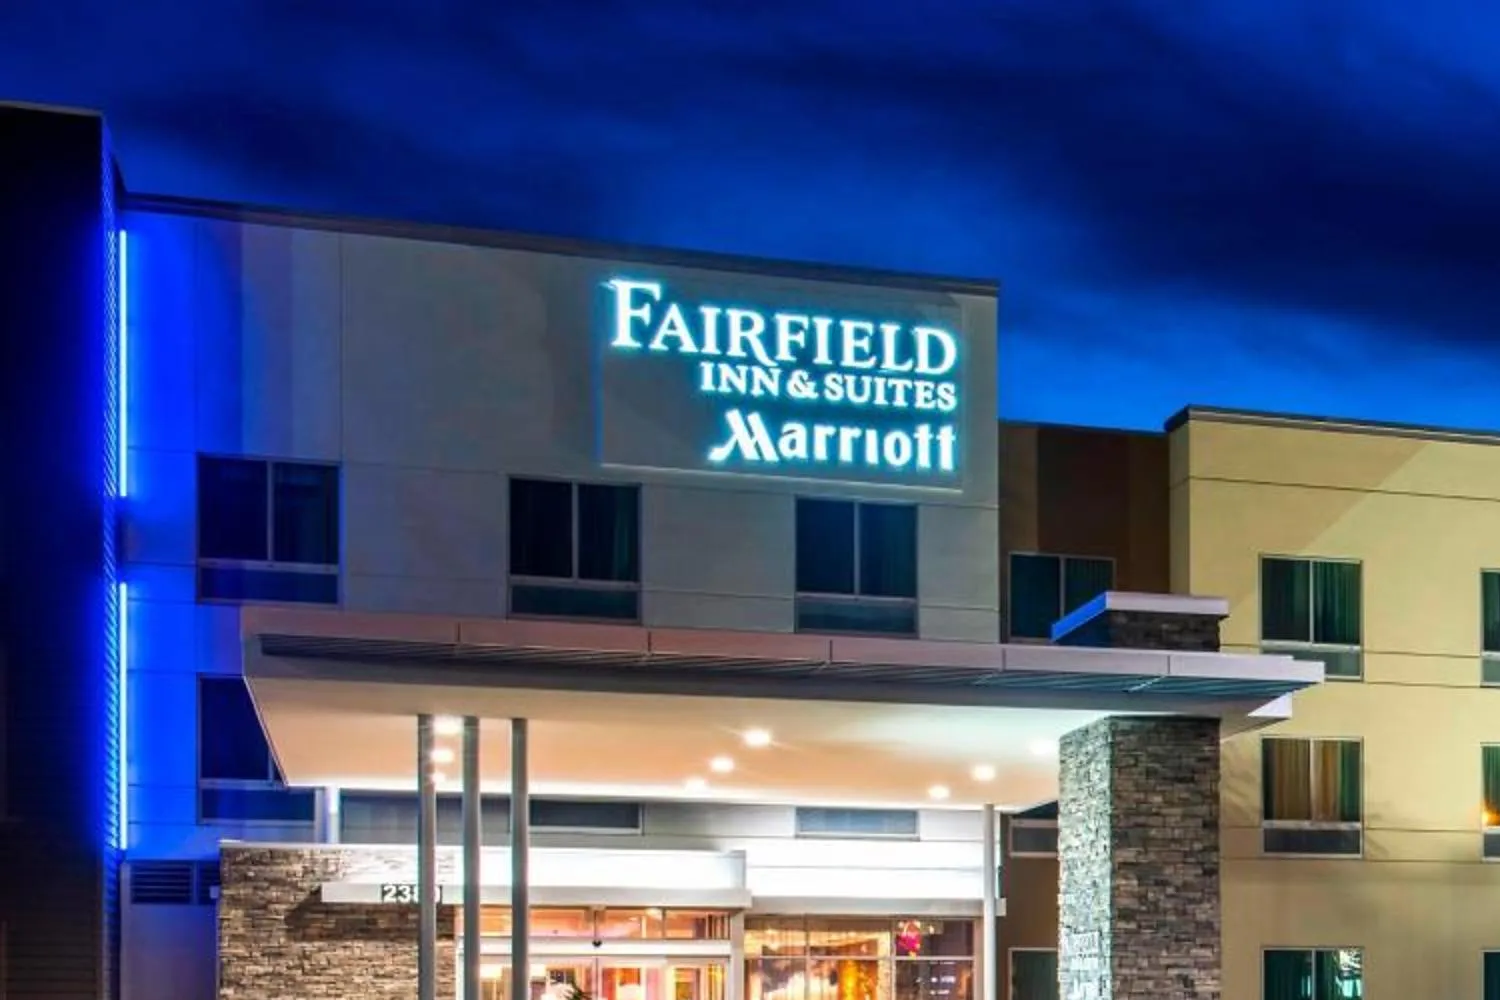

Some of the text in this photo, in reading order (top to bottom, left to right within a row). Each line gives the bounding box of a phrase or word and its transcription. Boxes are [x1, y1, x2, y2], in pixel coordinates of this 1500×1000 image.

[604, 278, 958, 376] FAIRFIELD
[700, 361, 958, 413] INN & SUITES
[707, 408, 957, 473] Marriott
